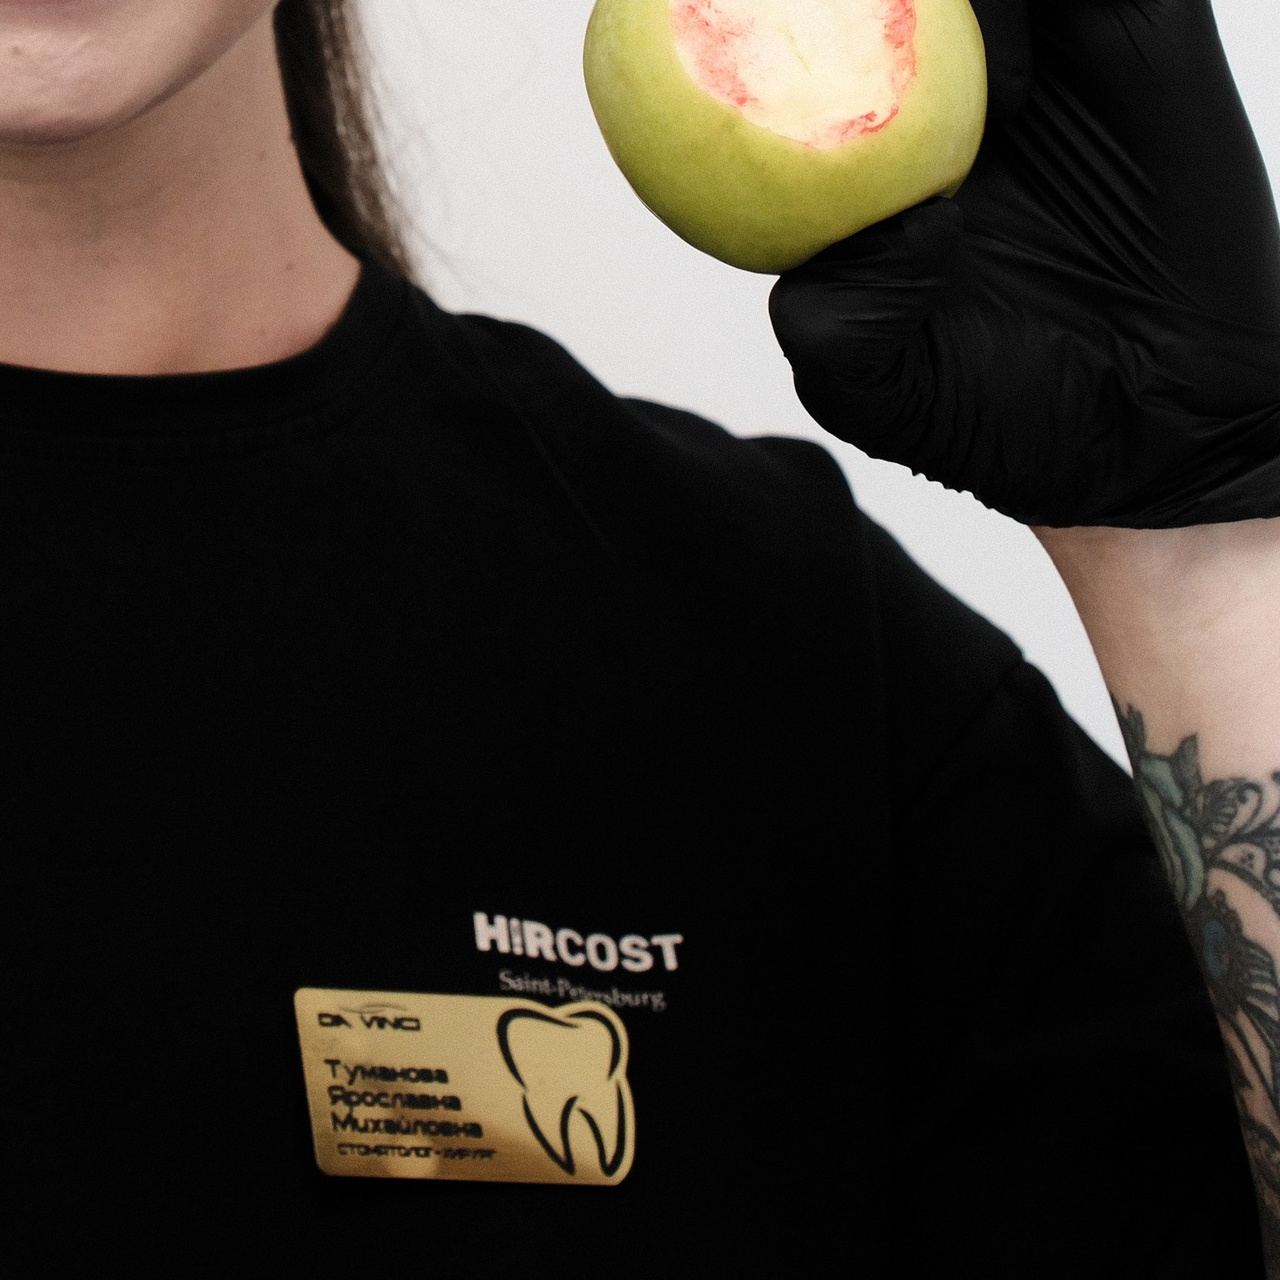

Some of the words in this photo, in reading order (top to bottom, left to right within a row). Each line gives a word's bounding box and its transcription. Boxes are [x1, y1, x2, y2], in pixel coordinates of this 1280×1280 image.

[318, 1012, 353, 1029] DA
[359, 1013, 421, 1032] VINCI
[324, 1058, 449, 1086] Туманова
[327, 1085, 462, 1116] Ярославна
[330, 1112, 484, 1139] Михайловна
